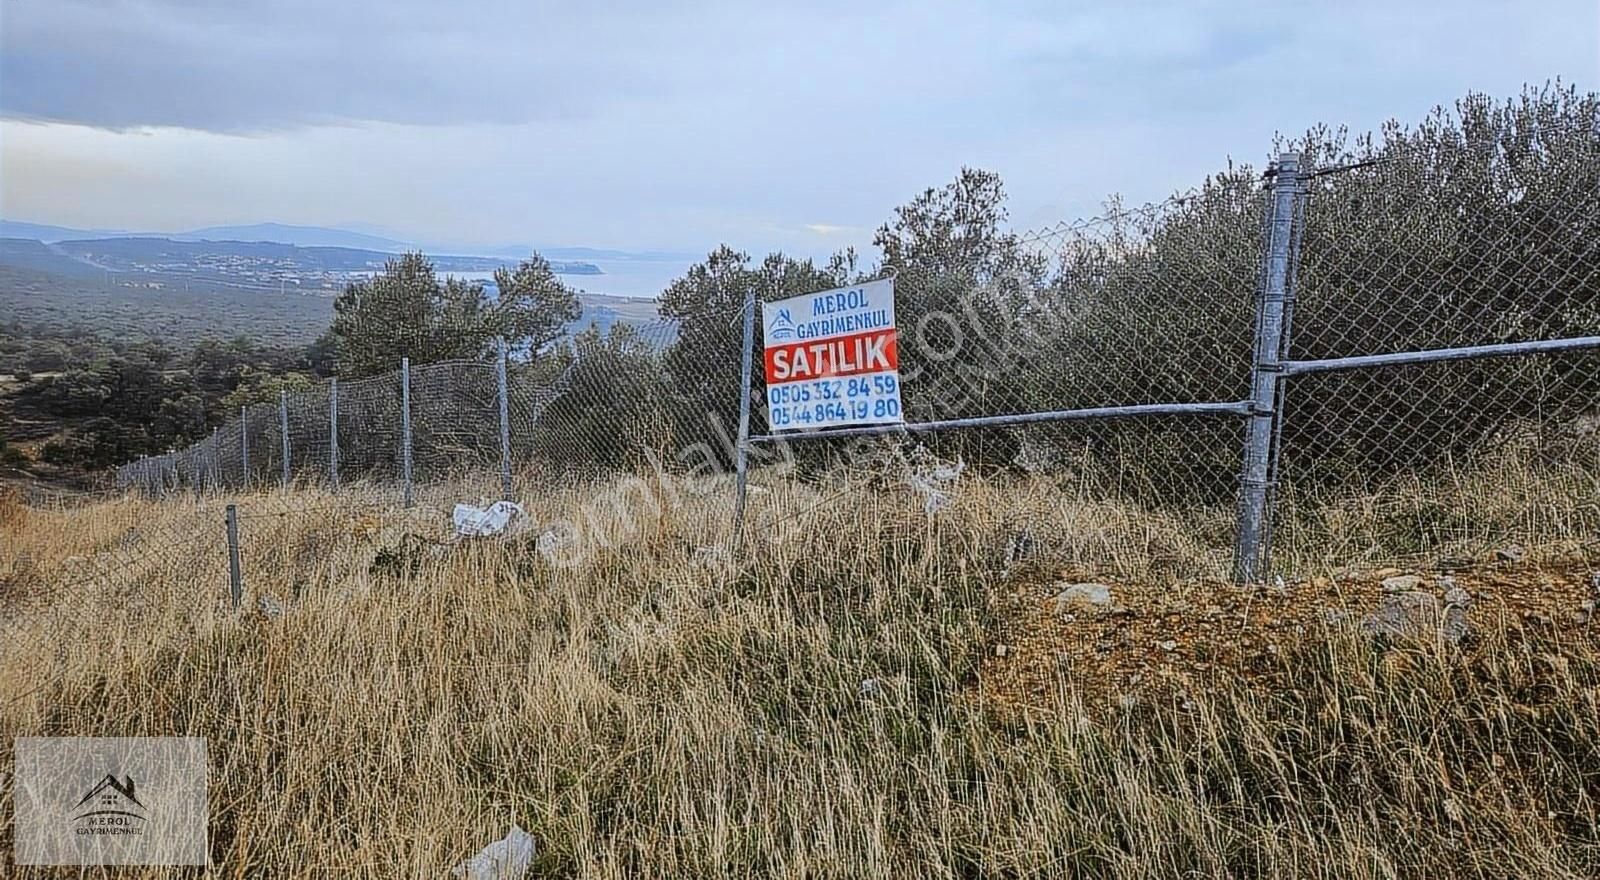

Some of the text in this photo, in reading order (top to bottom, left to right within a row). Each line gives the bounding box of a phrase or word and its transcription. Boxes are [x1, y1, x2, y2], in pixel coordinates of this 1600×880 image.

[813, 289, 869, 317] MEROL
[796, 309, 890, 339] GAYRİMENKUL
[773, 334, 890, 379] SATILIK
[771, 374, 896, 405] 0505 332 84 59
[772, 398, 899, 425] 0544 864 19 80
